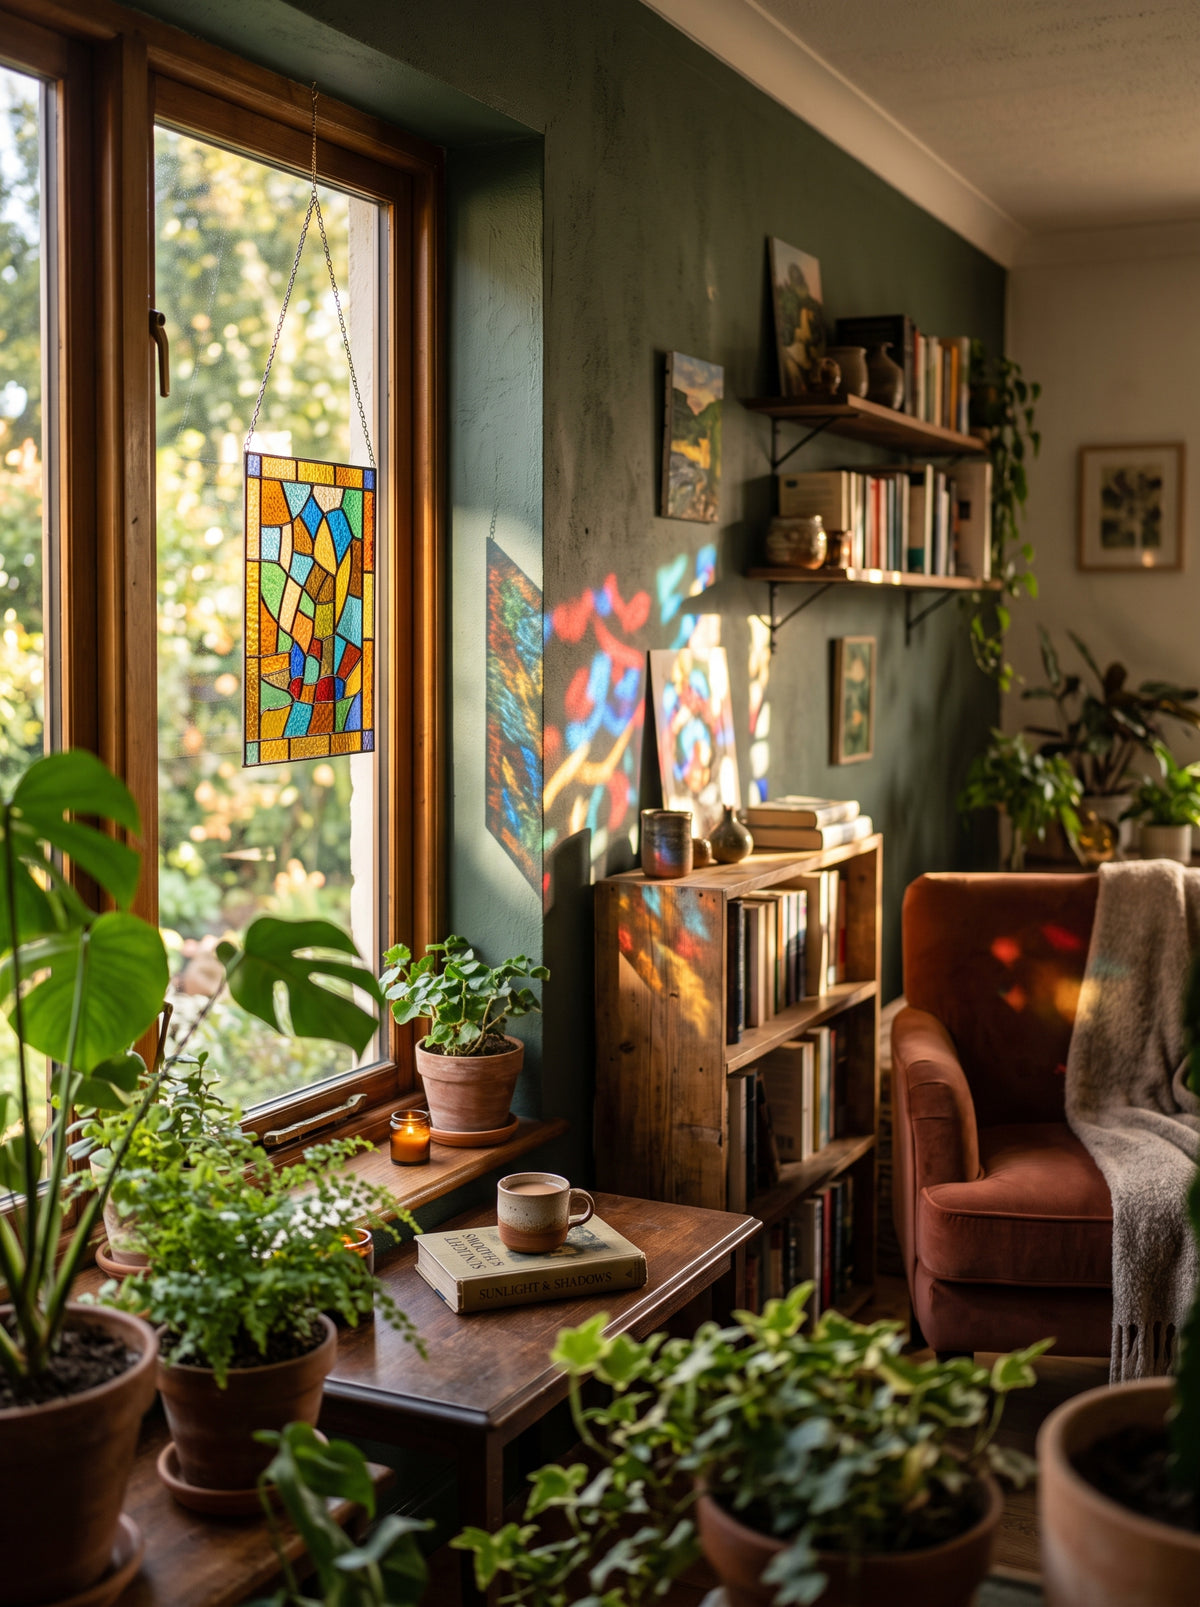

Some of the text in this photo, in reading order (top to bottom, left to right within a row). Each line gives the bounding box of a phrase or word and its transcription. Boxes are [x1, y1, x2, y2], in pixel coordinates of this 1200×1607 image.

[479, 1271, 612, 1301] SUNLIGHT & SHADOWS
